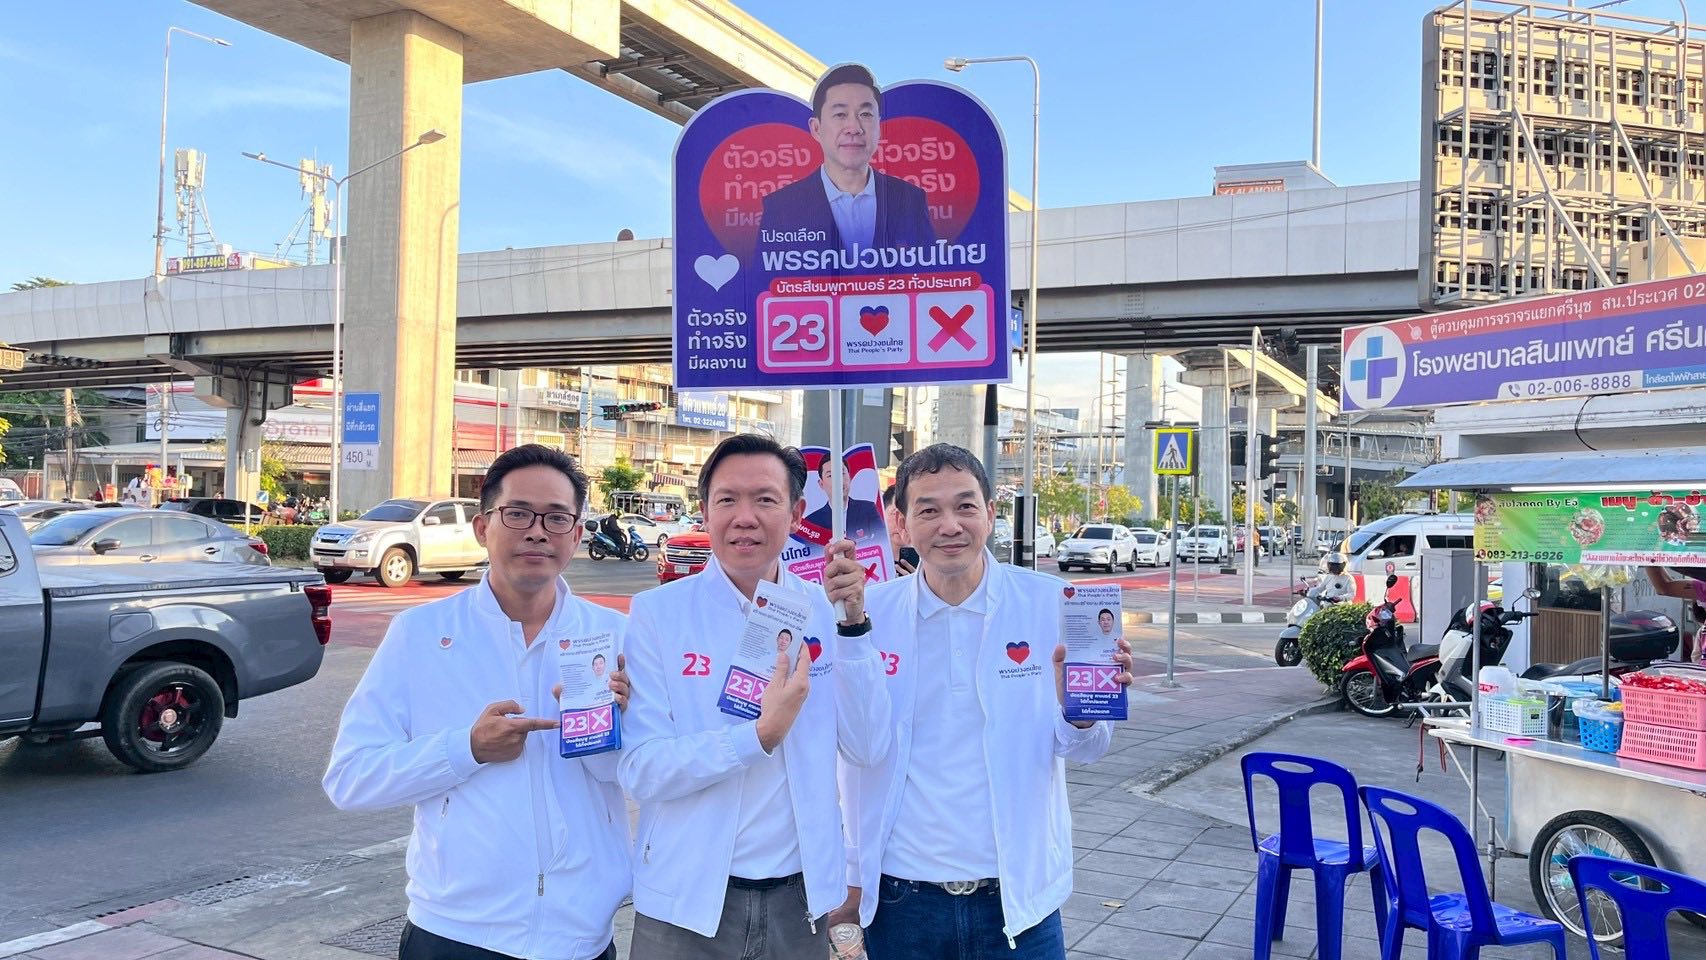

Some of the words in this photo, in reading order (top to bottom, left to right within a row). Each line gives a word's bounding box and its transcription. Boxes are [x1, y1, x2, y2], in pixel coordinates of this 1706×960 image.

[723, 143, 811, 169] ตัวจริง
[761, 228, 826, 243] โปรดเลือก
[762, 239, 987, 271] พรรคปวงชนไทย
[776, 278, 885, 296] บัตรสีชมพูกาเบอร์
[888, 280, 905, 290] 23
[908, 273, 972, 291] ทั่วประเทศ
[687, 308, 747, 326] ตัวจริง
[1430, 299, 1592, 340] ตู้ควบคุมการจราจรแยกศรีนุช
[1602, 288, 1678, 311] สน.ประเวศ
[688, 330, 747, 349] ทำจริง
[772, 313, 826, 351] 23
[846, 337, 903, 347] พรรคปวงชนไทย
[1413, 325, 1635, 378] โรงพยาบาลสินแพทย์
[1646, 319, 1706, 352] ศรีน
[688, 355, 746, 370] มีผลงาน
[1528, 374, 1631, 396] 02-006-8888
[345, 451, 363, 463] 450
[1487, 550, 1564, 560] 083-213-6926
[682, 653, 711, 676] 23
[729, 675, 753, 695] 23
[1069, 670, 1093, 687] 23
[564, 716, 588, 733] 23
